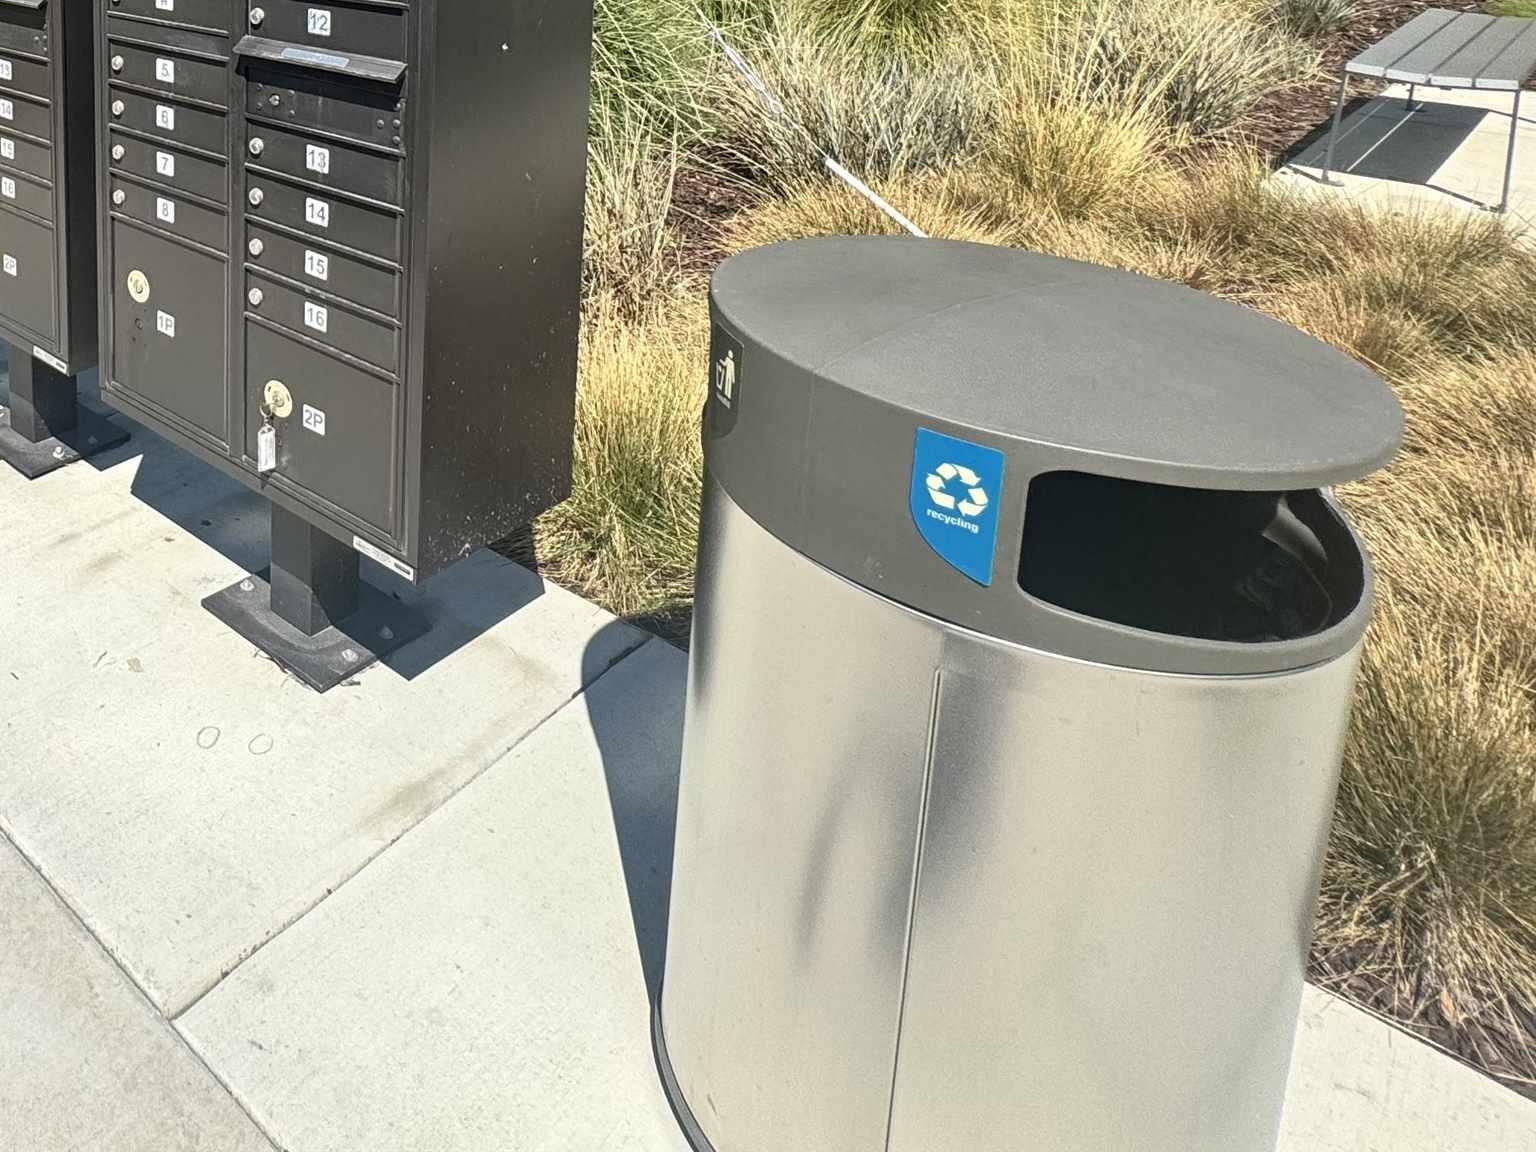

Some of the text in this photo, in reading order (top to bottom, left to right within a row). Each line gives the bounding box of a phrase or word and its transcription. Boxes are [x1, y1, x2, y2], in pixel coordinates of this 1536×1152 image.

[310, 13, 328, 31] 12
[161, 63, 170, 78] 5
[161, 156, 169, 171] 7
[308, 149, 326, 170] 13
[161, 202, 169, 217] 8
[308, 203, 326, 224] 14
[308, 256, 325, 275] 15
[159, 315, 173, 331] 1P
[308, 307, 325, 328] 16
[305, 410, 322, 427] 2P
[926, 508, 979, 534] recycling
